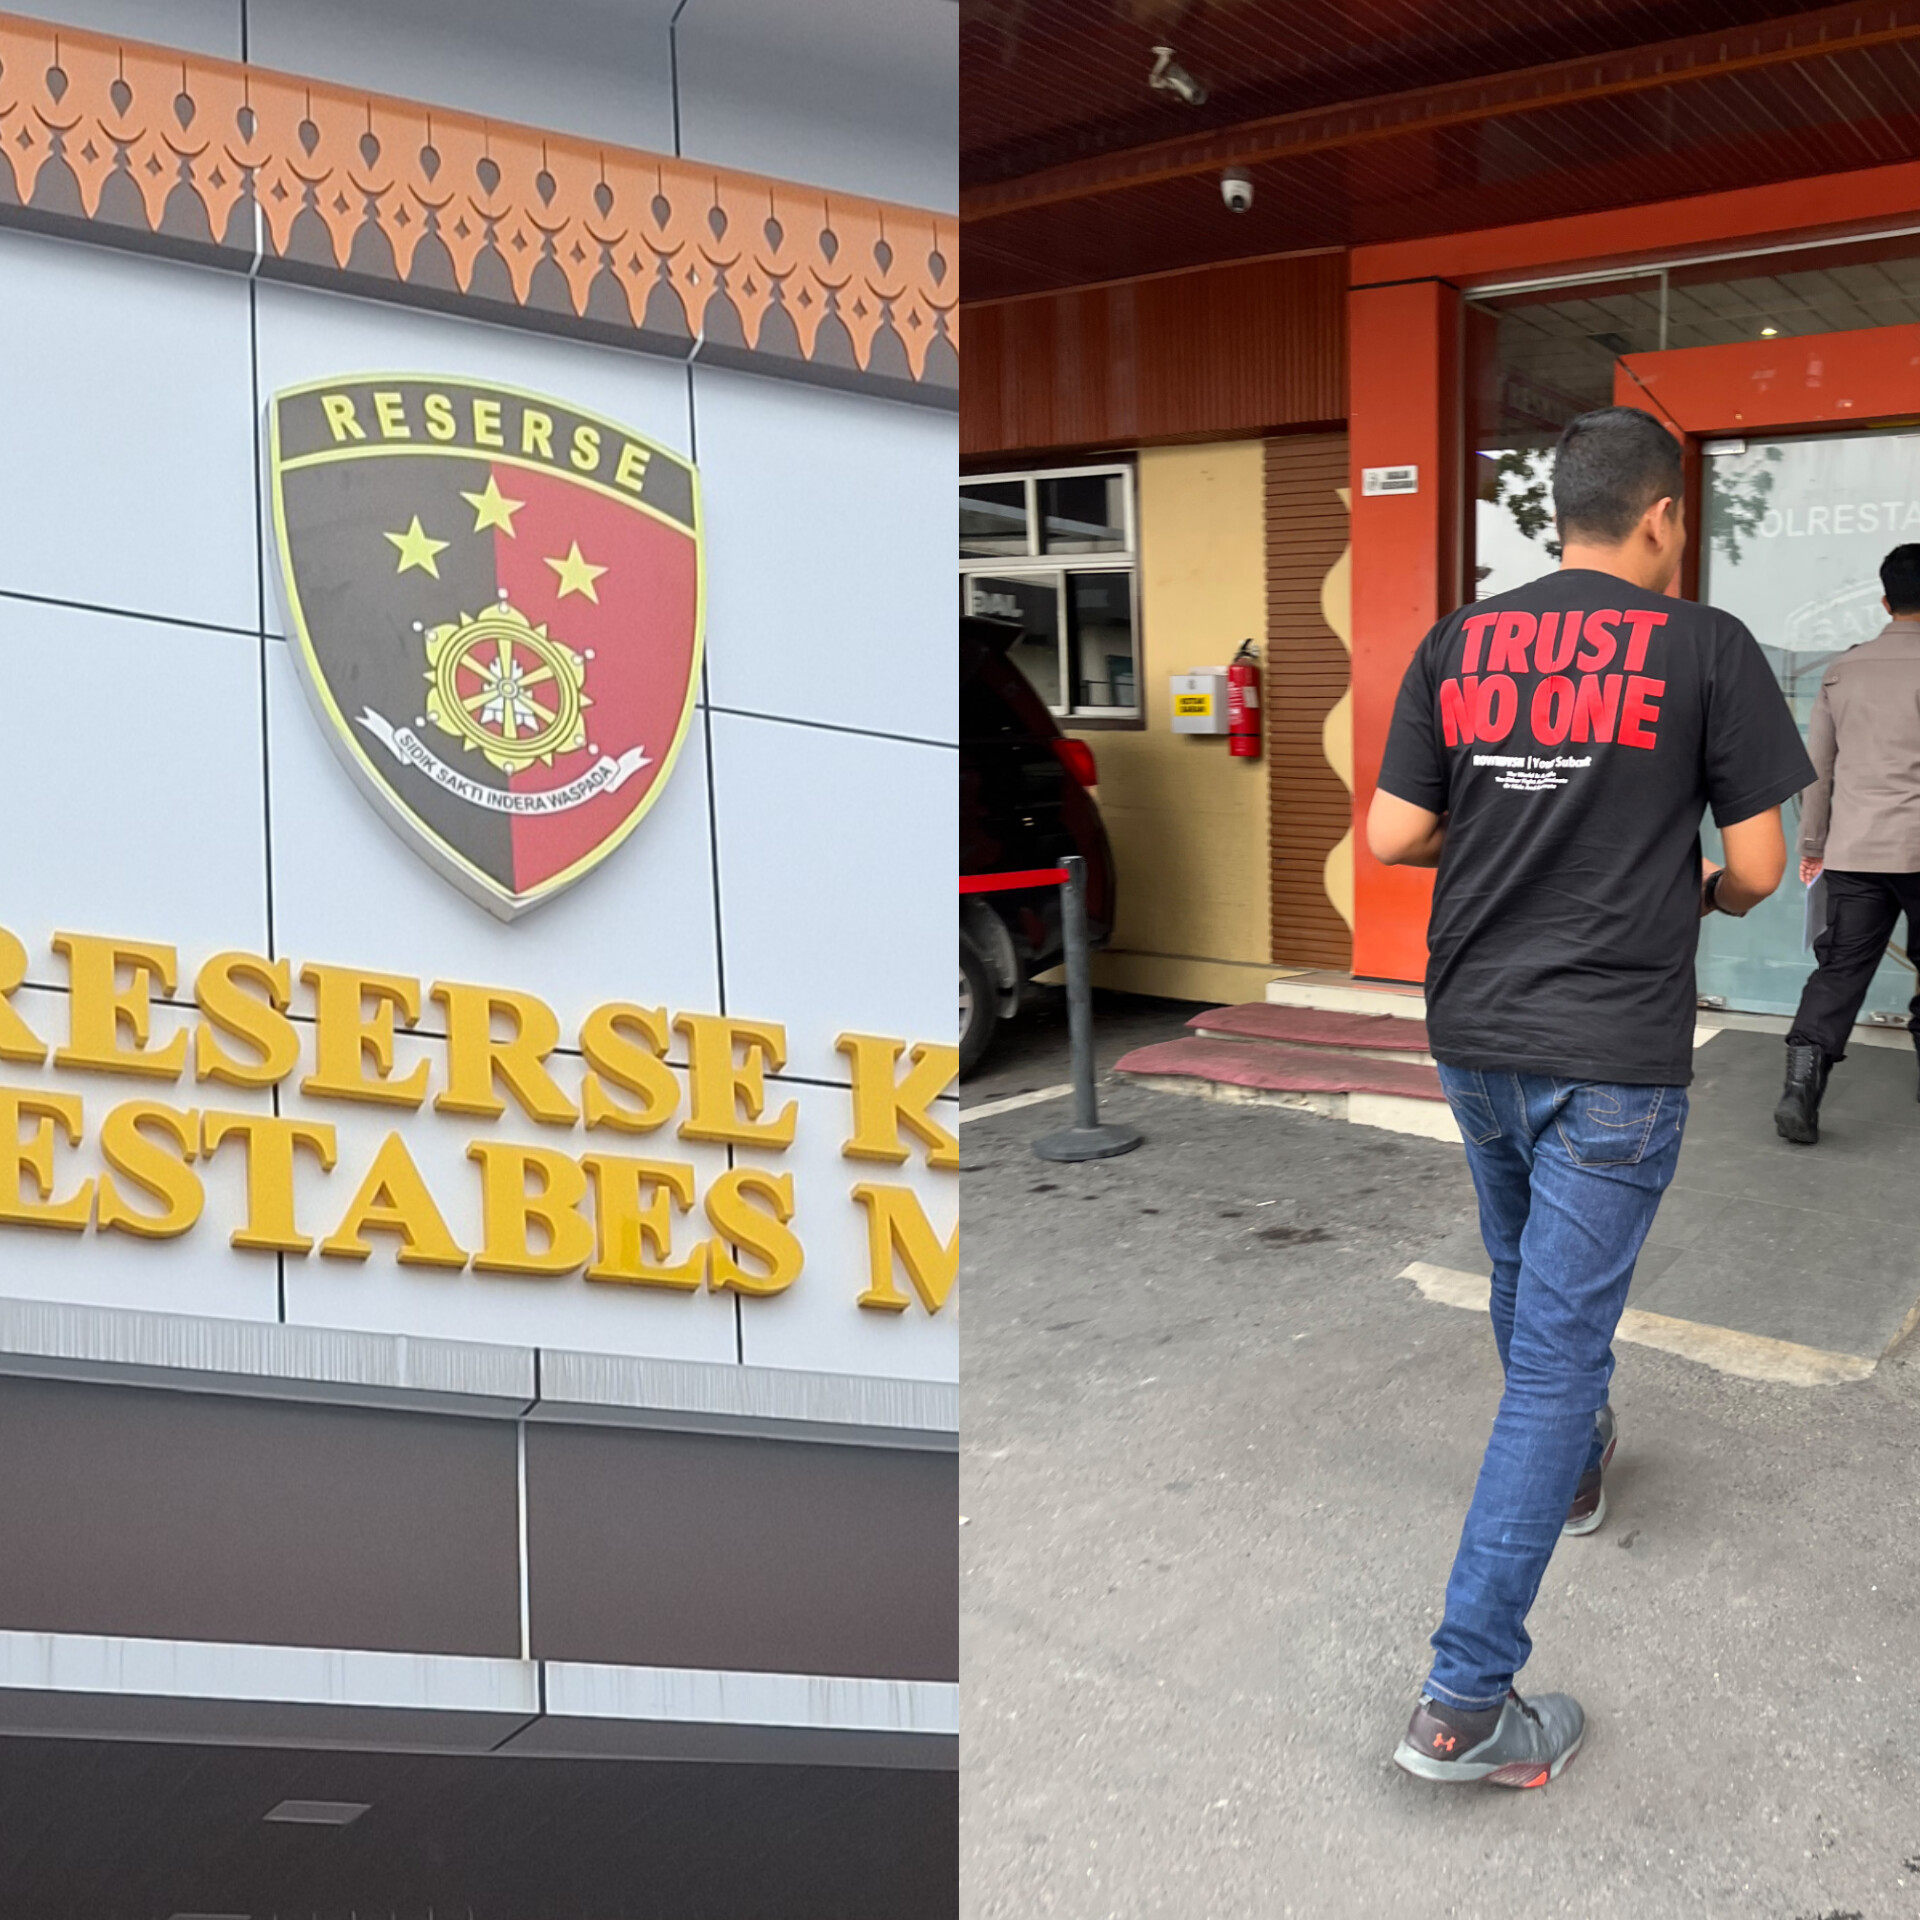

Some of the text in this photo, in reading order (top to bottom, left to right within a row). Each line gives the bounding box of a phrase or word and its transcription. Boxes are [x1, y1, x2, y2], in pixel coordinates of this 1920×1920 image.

[321, 392, 651, 492] RESERSE
[1735, 501, 1920, 539] OLRESTA
[1461, 609, 1669, 674] TRUST
[1440, 674, 1666, 750] NO ONE
[400, 734, 613, 811] SIDIK SAKTI INDERA WASPADA
